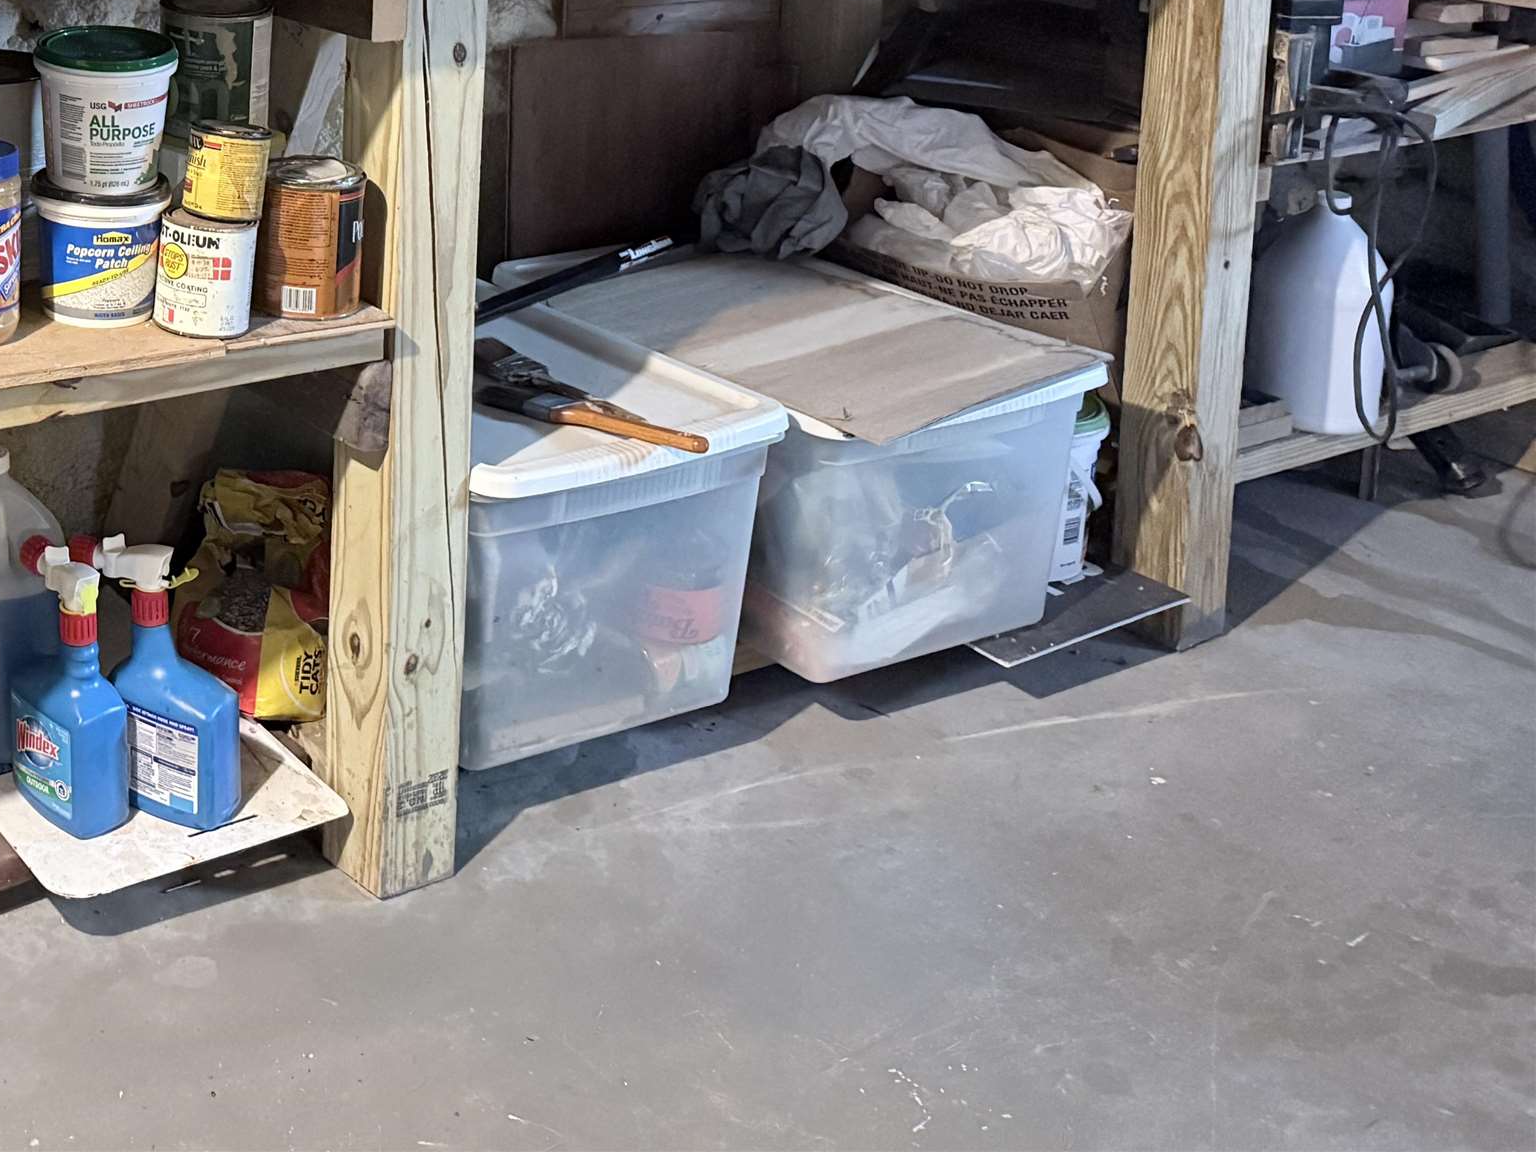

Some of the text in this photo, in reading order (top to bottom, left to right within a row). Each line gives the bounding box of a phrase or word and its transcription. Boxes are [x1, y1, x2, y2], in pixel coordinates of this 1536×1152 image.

[89, 102, 107, 110] USG
[89, 114, 120, 128] ALL
[89, 122, 156, 141] PURPOSE
[95, 234, 130, 243] Homax
[66, 242, 152, 258] Popcorn Ceiling
[163, 249, 184, 260] STOPS
[95, 258, 129, 269] Patch
[164, 258, 183, 271] RUST
[177, 281, 209, 294] COATING
[935, 275, 954, 286] DO
[957, 278, 984, 292] NOT
[989, 285, 1029, 297] DROP
[957, 291, 987, 304] PAS
[978, 305, 1070, 321] DEJAR CAER
[298, 650, 314, 695] TIDY
[309, 648, 323, 696] CATS
[16, 717, 60, 761] Windex
